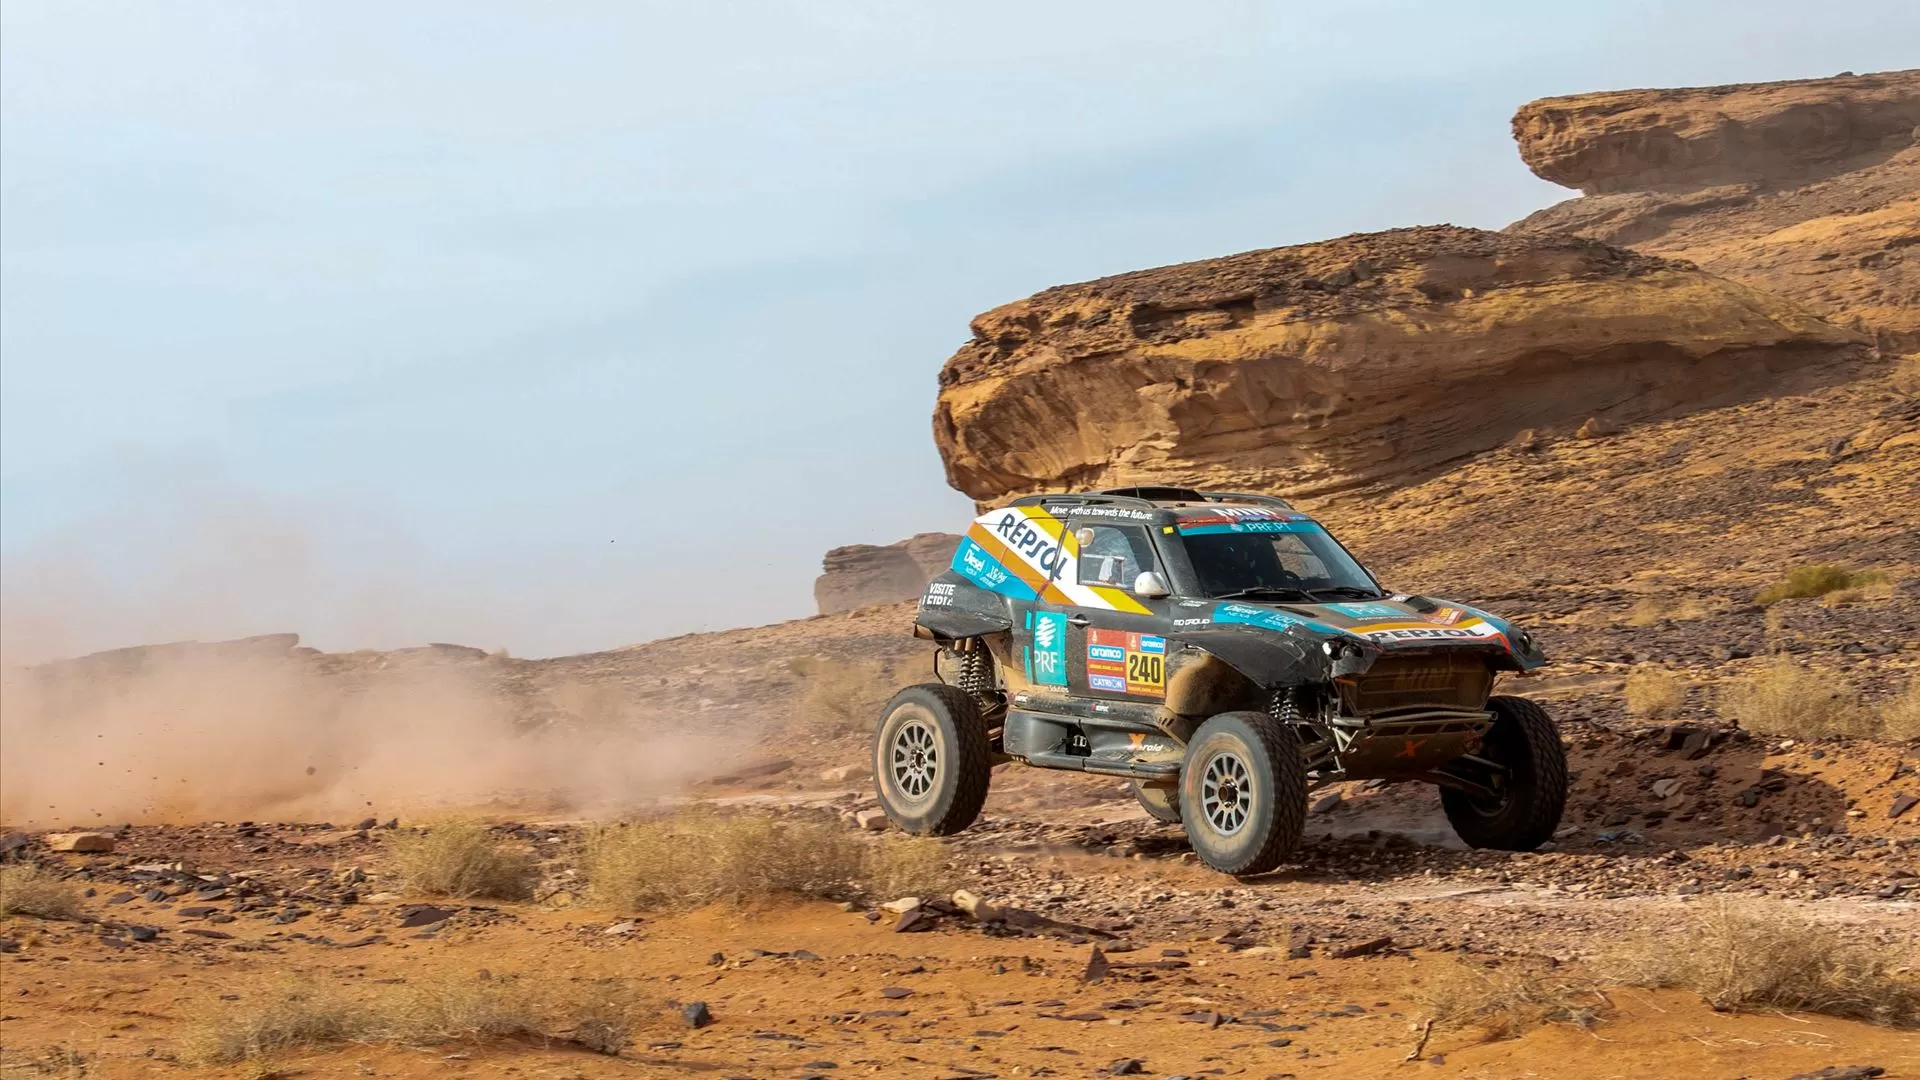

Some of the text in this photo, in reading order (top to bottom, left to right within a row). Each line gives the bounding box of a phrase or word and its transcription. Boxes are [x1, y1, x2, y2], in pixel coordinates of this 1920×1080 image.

[1050, 506, 1068, 514] Move
[1092, 507, 1118, 517] towards
[1119, 508, 1130, 518] the
[1246, 522, 1292, 531] PRF.PT
[997, 513, 1068, 580] REPSOL
[964, 549, 985, 572] Diesel
[930, 583, 955, 595] VISITE
[1033, 650, 1058, 673] PRF
[1091, 647, 1122, 659] aramco
[1129, 654, 1161, 683] 240
